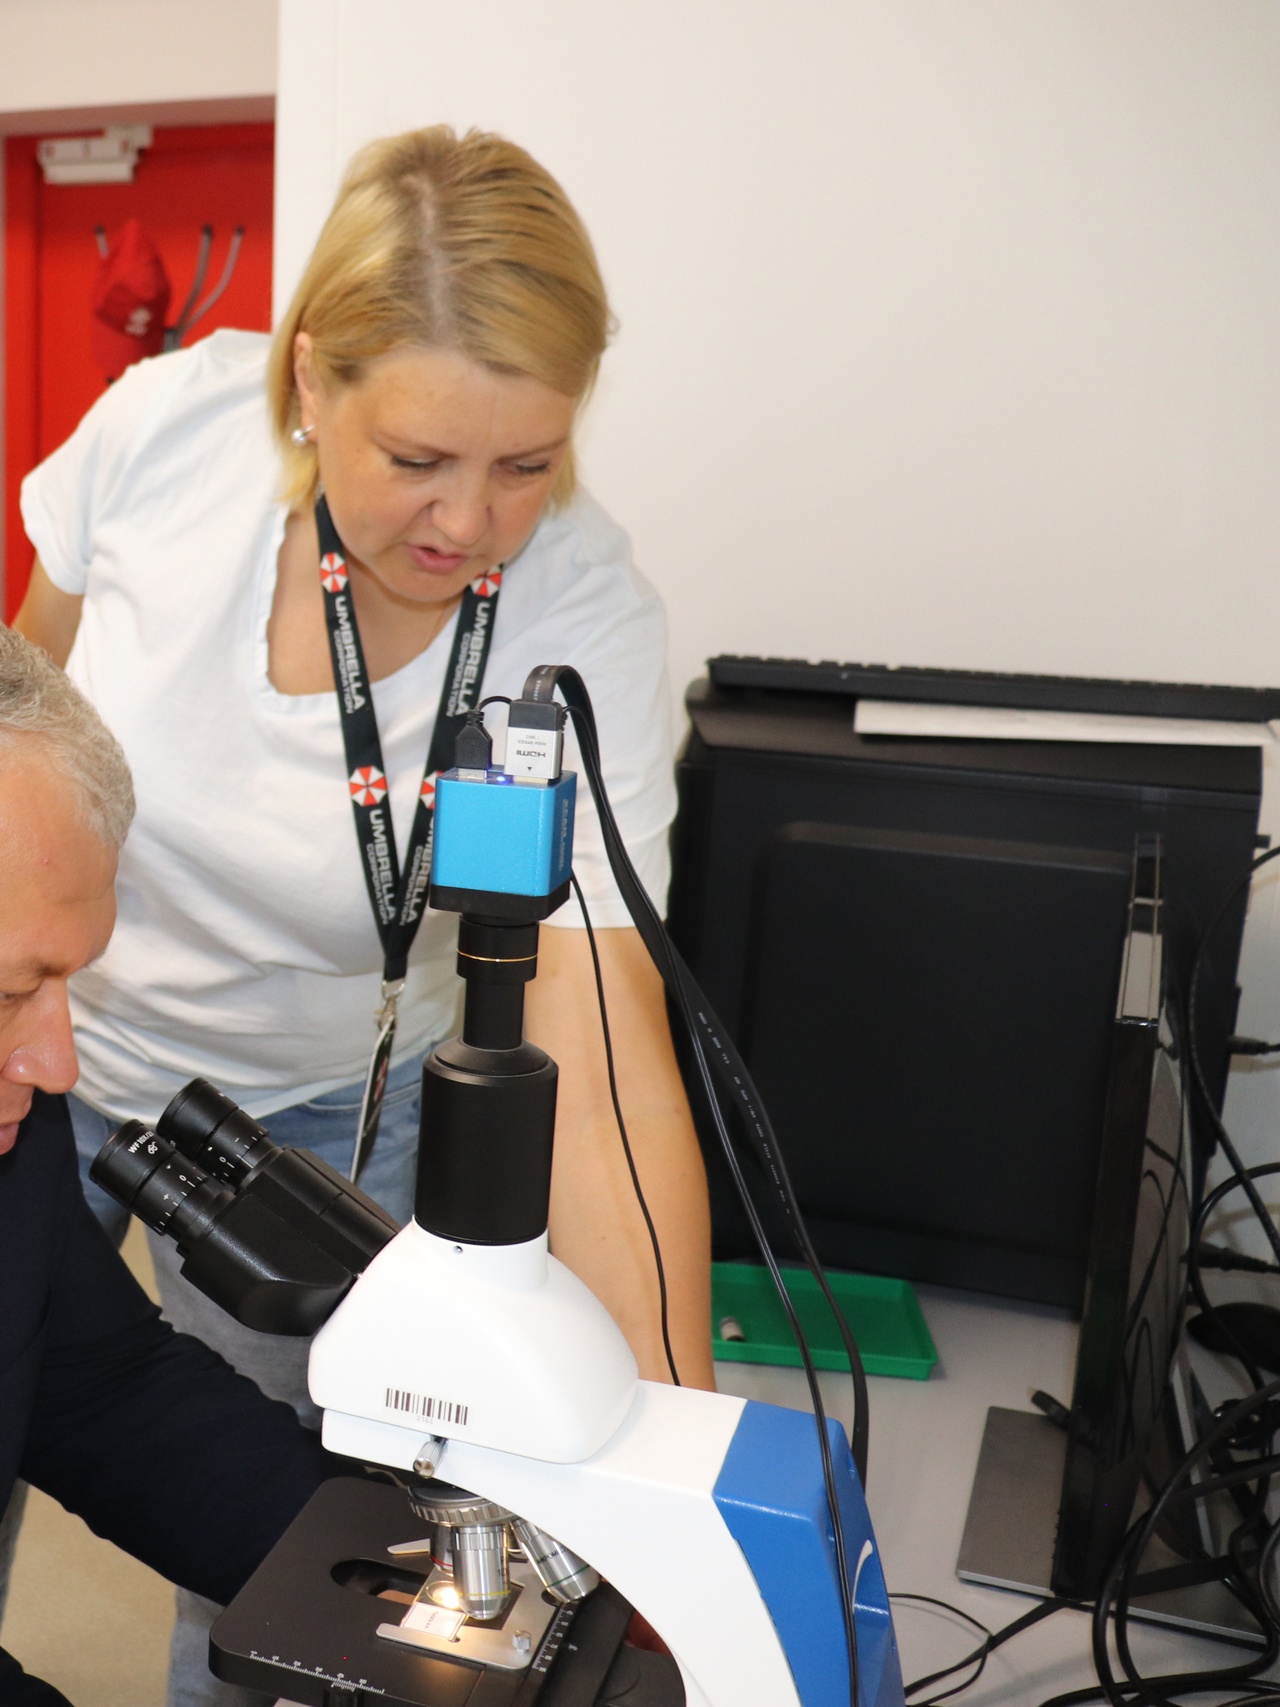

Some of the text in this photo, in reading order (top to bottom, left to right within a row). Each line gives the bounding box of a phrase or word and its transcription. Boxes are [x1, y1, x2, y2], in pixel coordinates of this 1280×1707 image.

[333, 629, 354, 715] CORPORATION
[334, 595, 366, 711] UMBRELLA
[445, 632, 472, 718] CORPORATION
[455, 601, 491, 716] UMBRELLA
[366, 842, 389, 926] CORPORATION
[369, 808, 397, 921] UMBRELLA
[399, 844, 424, 926] CORPORATION
